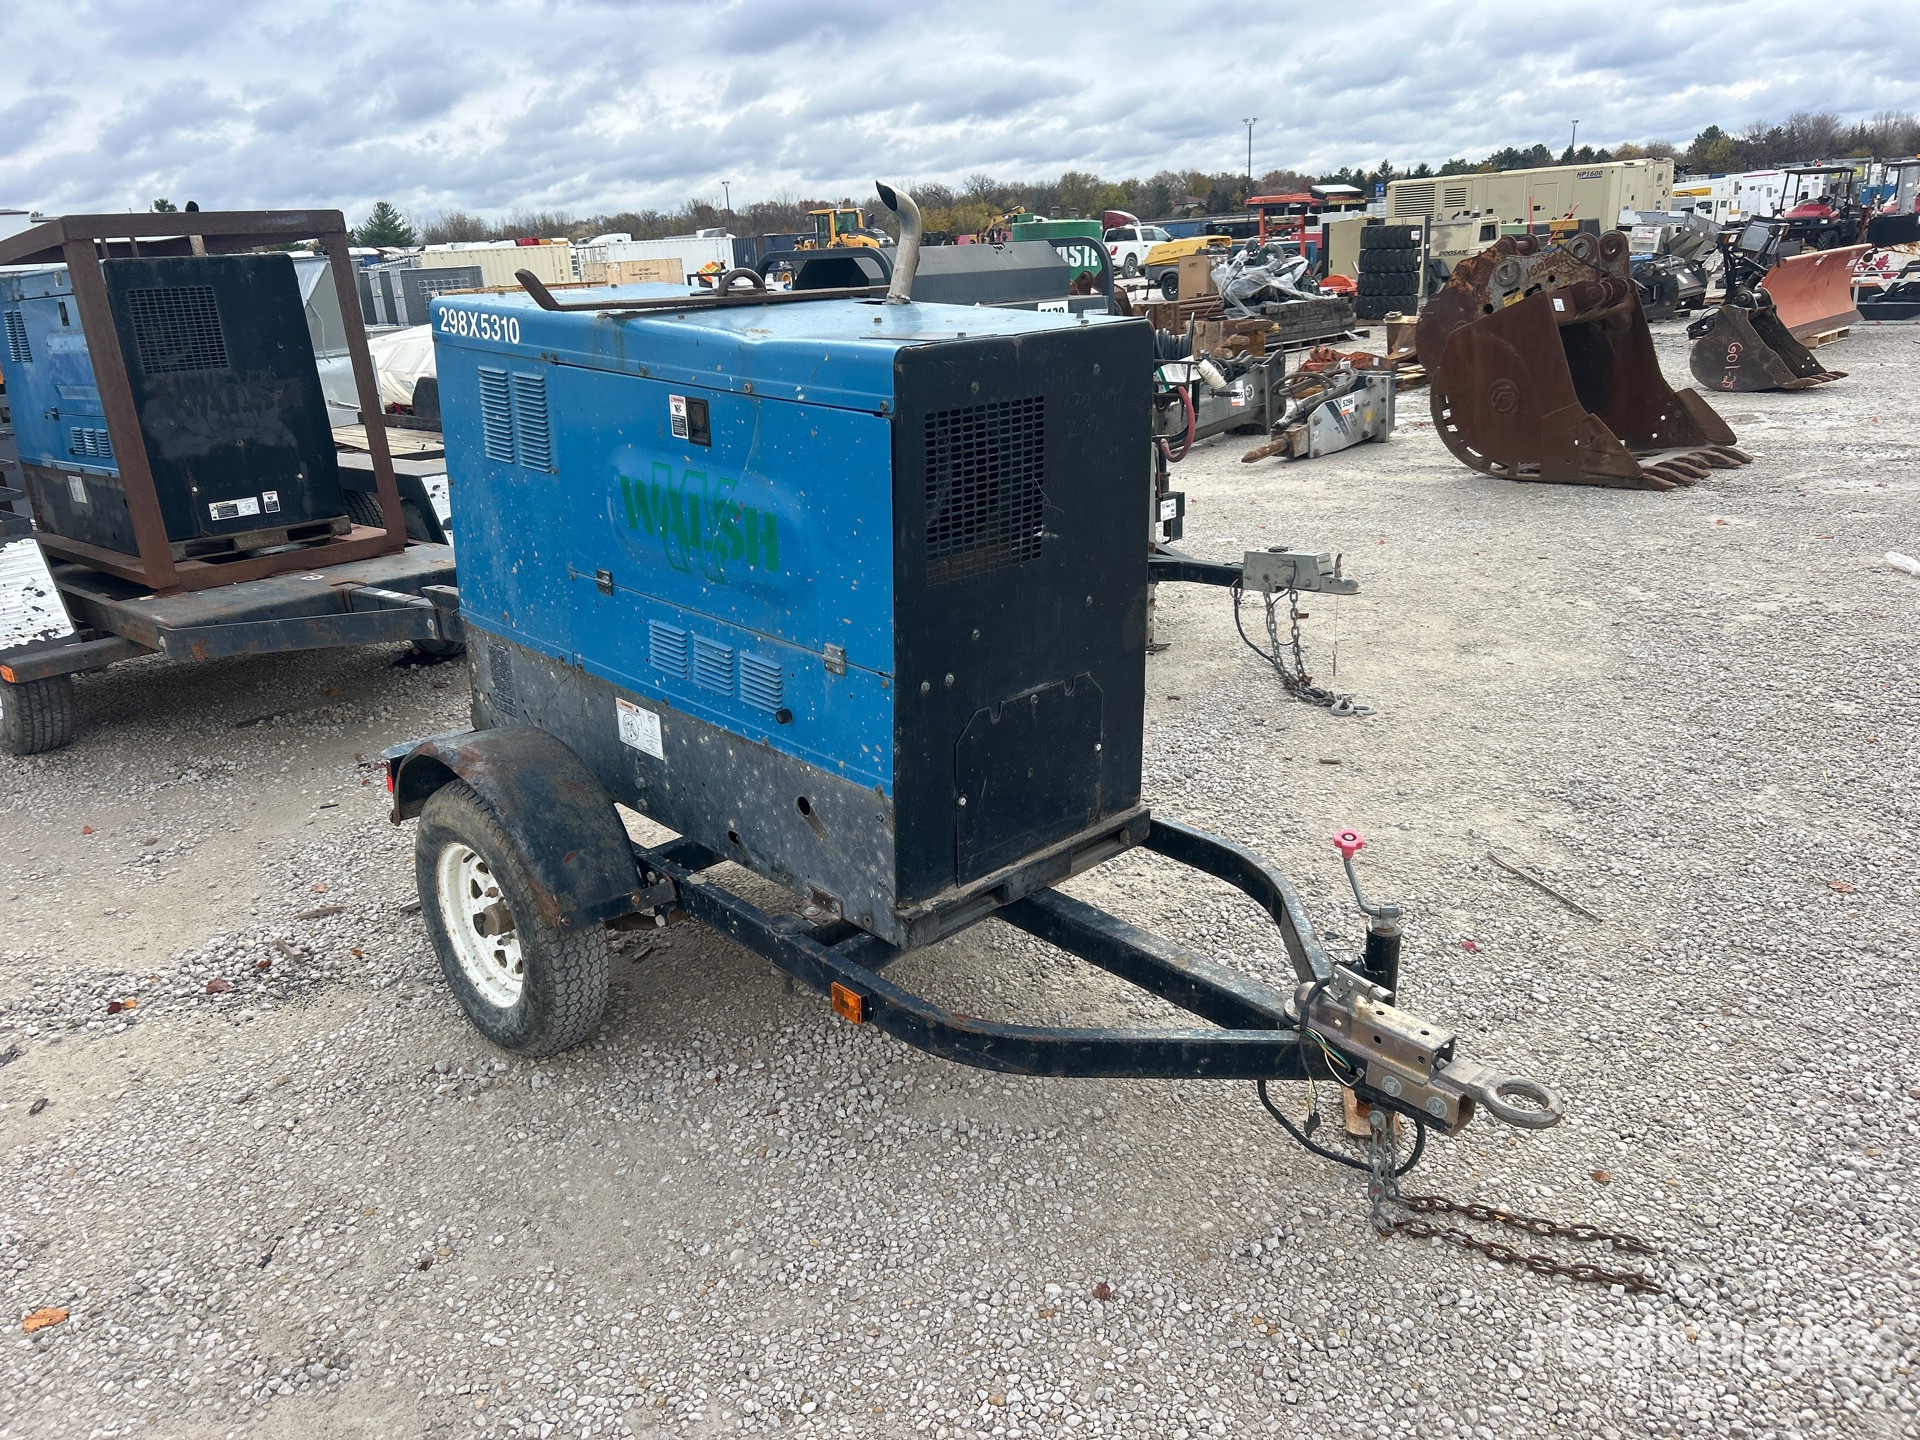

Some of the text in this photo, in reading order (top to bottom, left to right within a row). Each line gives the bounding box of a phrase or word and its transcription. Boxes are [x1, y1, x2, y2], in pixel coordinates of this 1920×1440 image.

[1576, 170, 1604, 178] HP1600
[438, 306, 520, 344] 298X5310
[1342, 397, 1354, 408] 5296
[619, 474, 779, 572] WALSH
